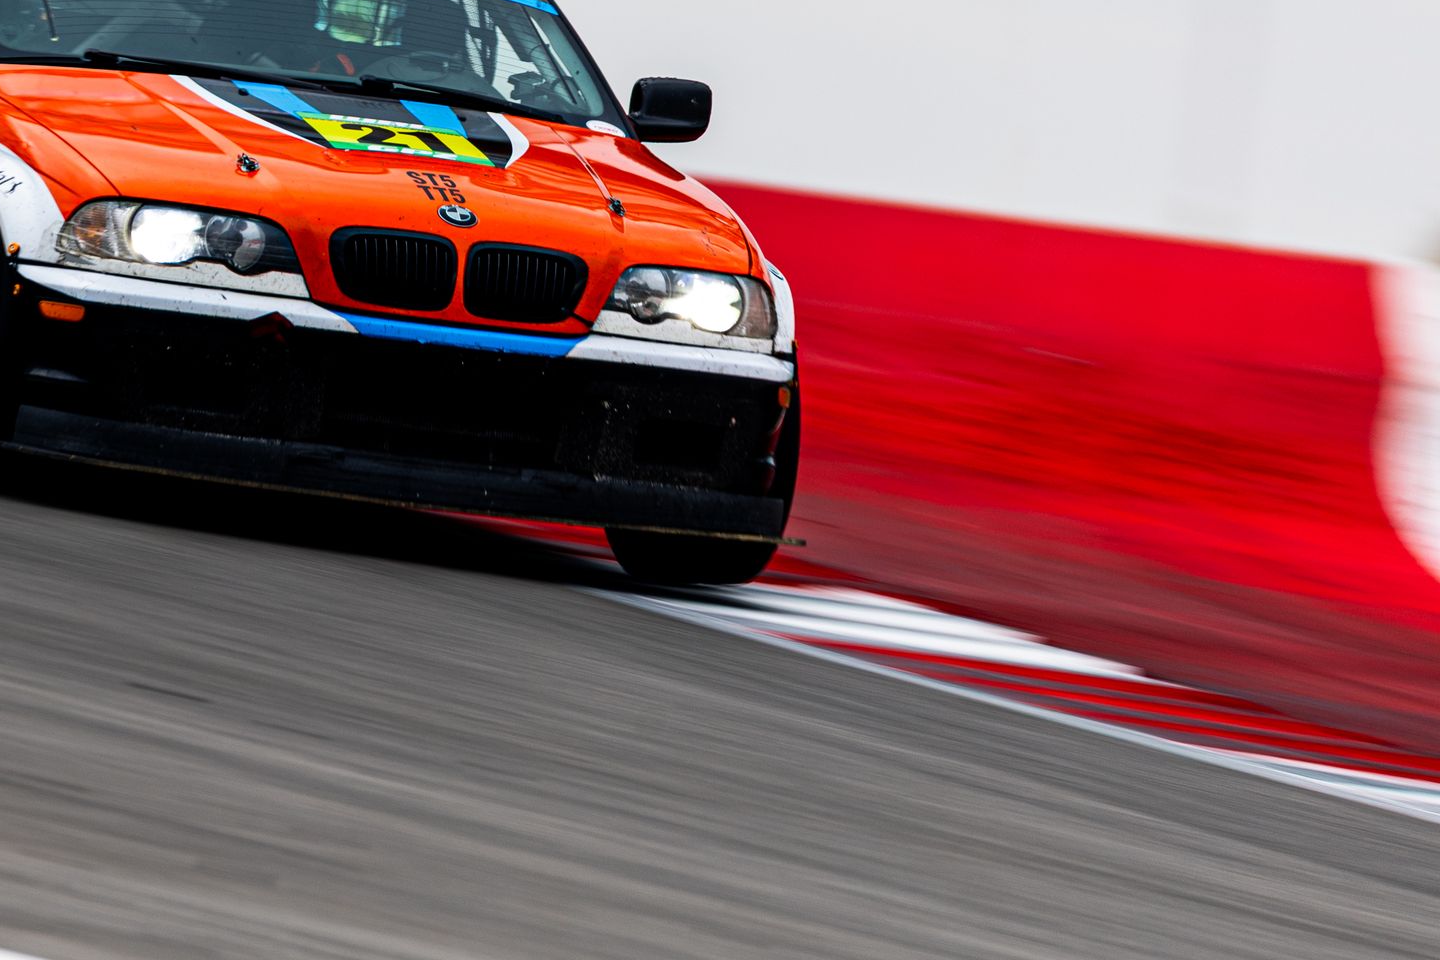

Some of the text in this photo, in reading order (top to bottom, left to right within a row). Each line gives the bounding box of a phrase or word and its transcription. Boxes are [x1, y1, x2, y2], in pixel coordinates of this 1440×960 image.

[341, 123, 455, 154] 21
[406, 170, 457, 189] ST5
[417, 184, 466, 204] TT5
